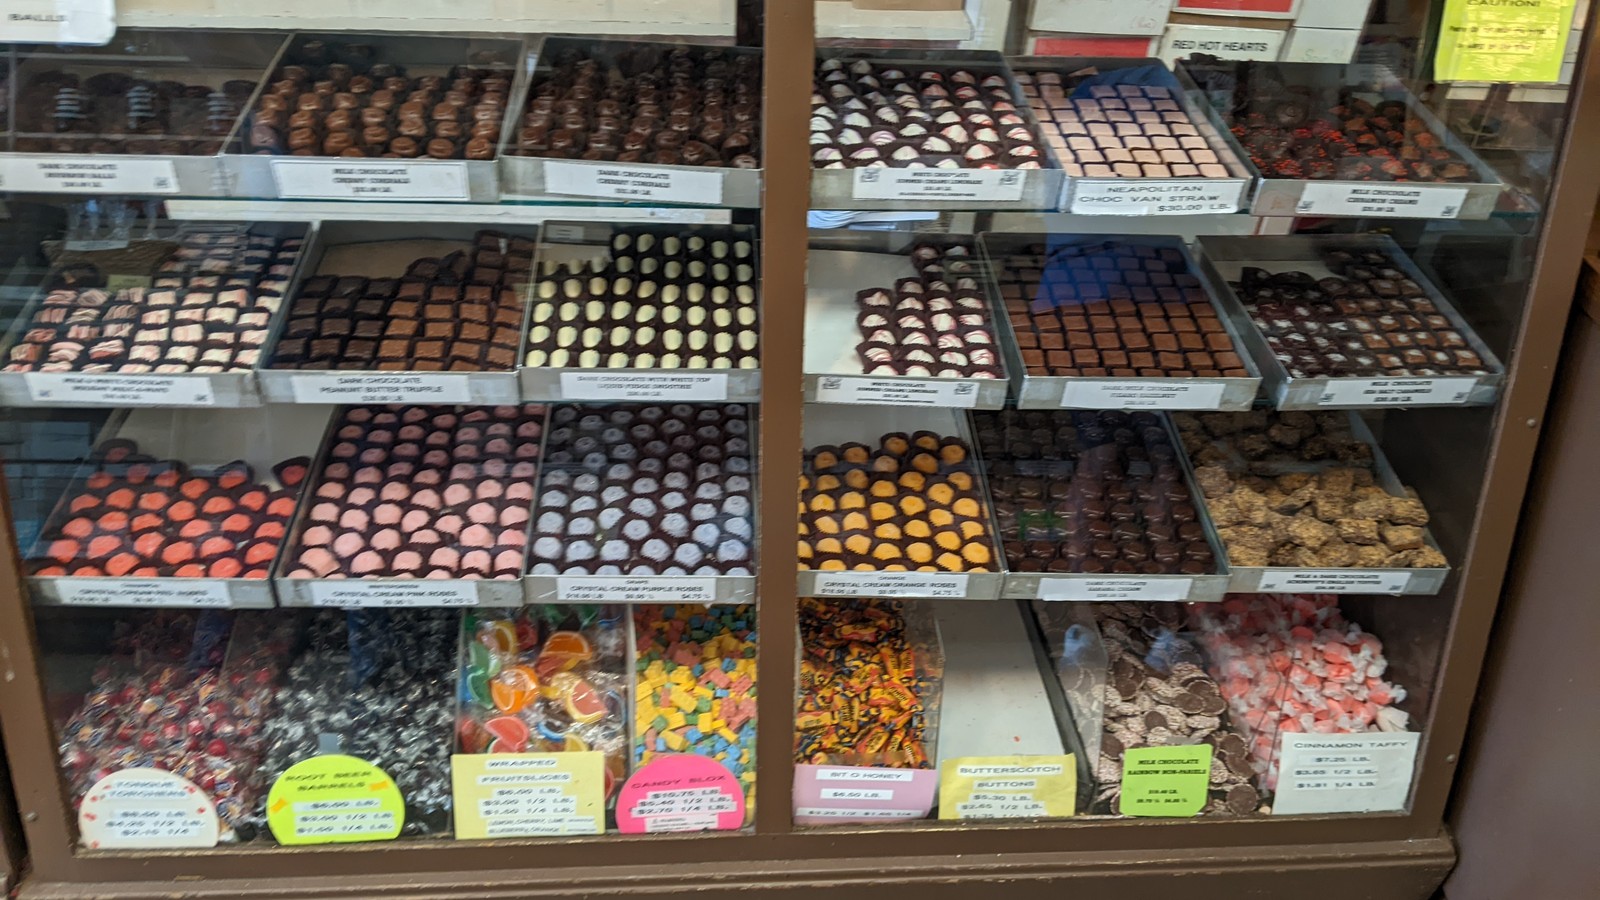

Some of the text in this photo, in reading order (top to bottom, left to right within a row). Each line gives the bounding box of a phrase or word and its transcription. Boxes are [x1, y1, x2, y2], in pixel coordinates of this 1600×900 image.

[1172, 39, 1269, 53] RED HOT HEARTS
[622, 171, 670, 179] CHOCOLATE
[960, 766, 1061, 774] BUTTERSCOTCH
[481, 774, 569, 782] FRUITSLICES
[297, 782, 365, 791] BARRELS
[631, 779, 682, 789] CANDY
[652, 790, 695, 799] $10.75
